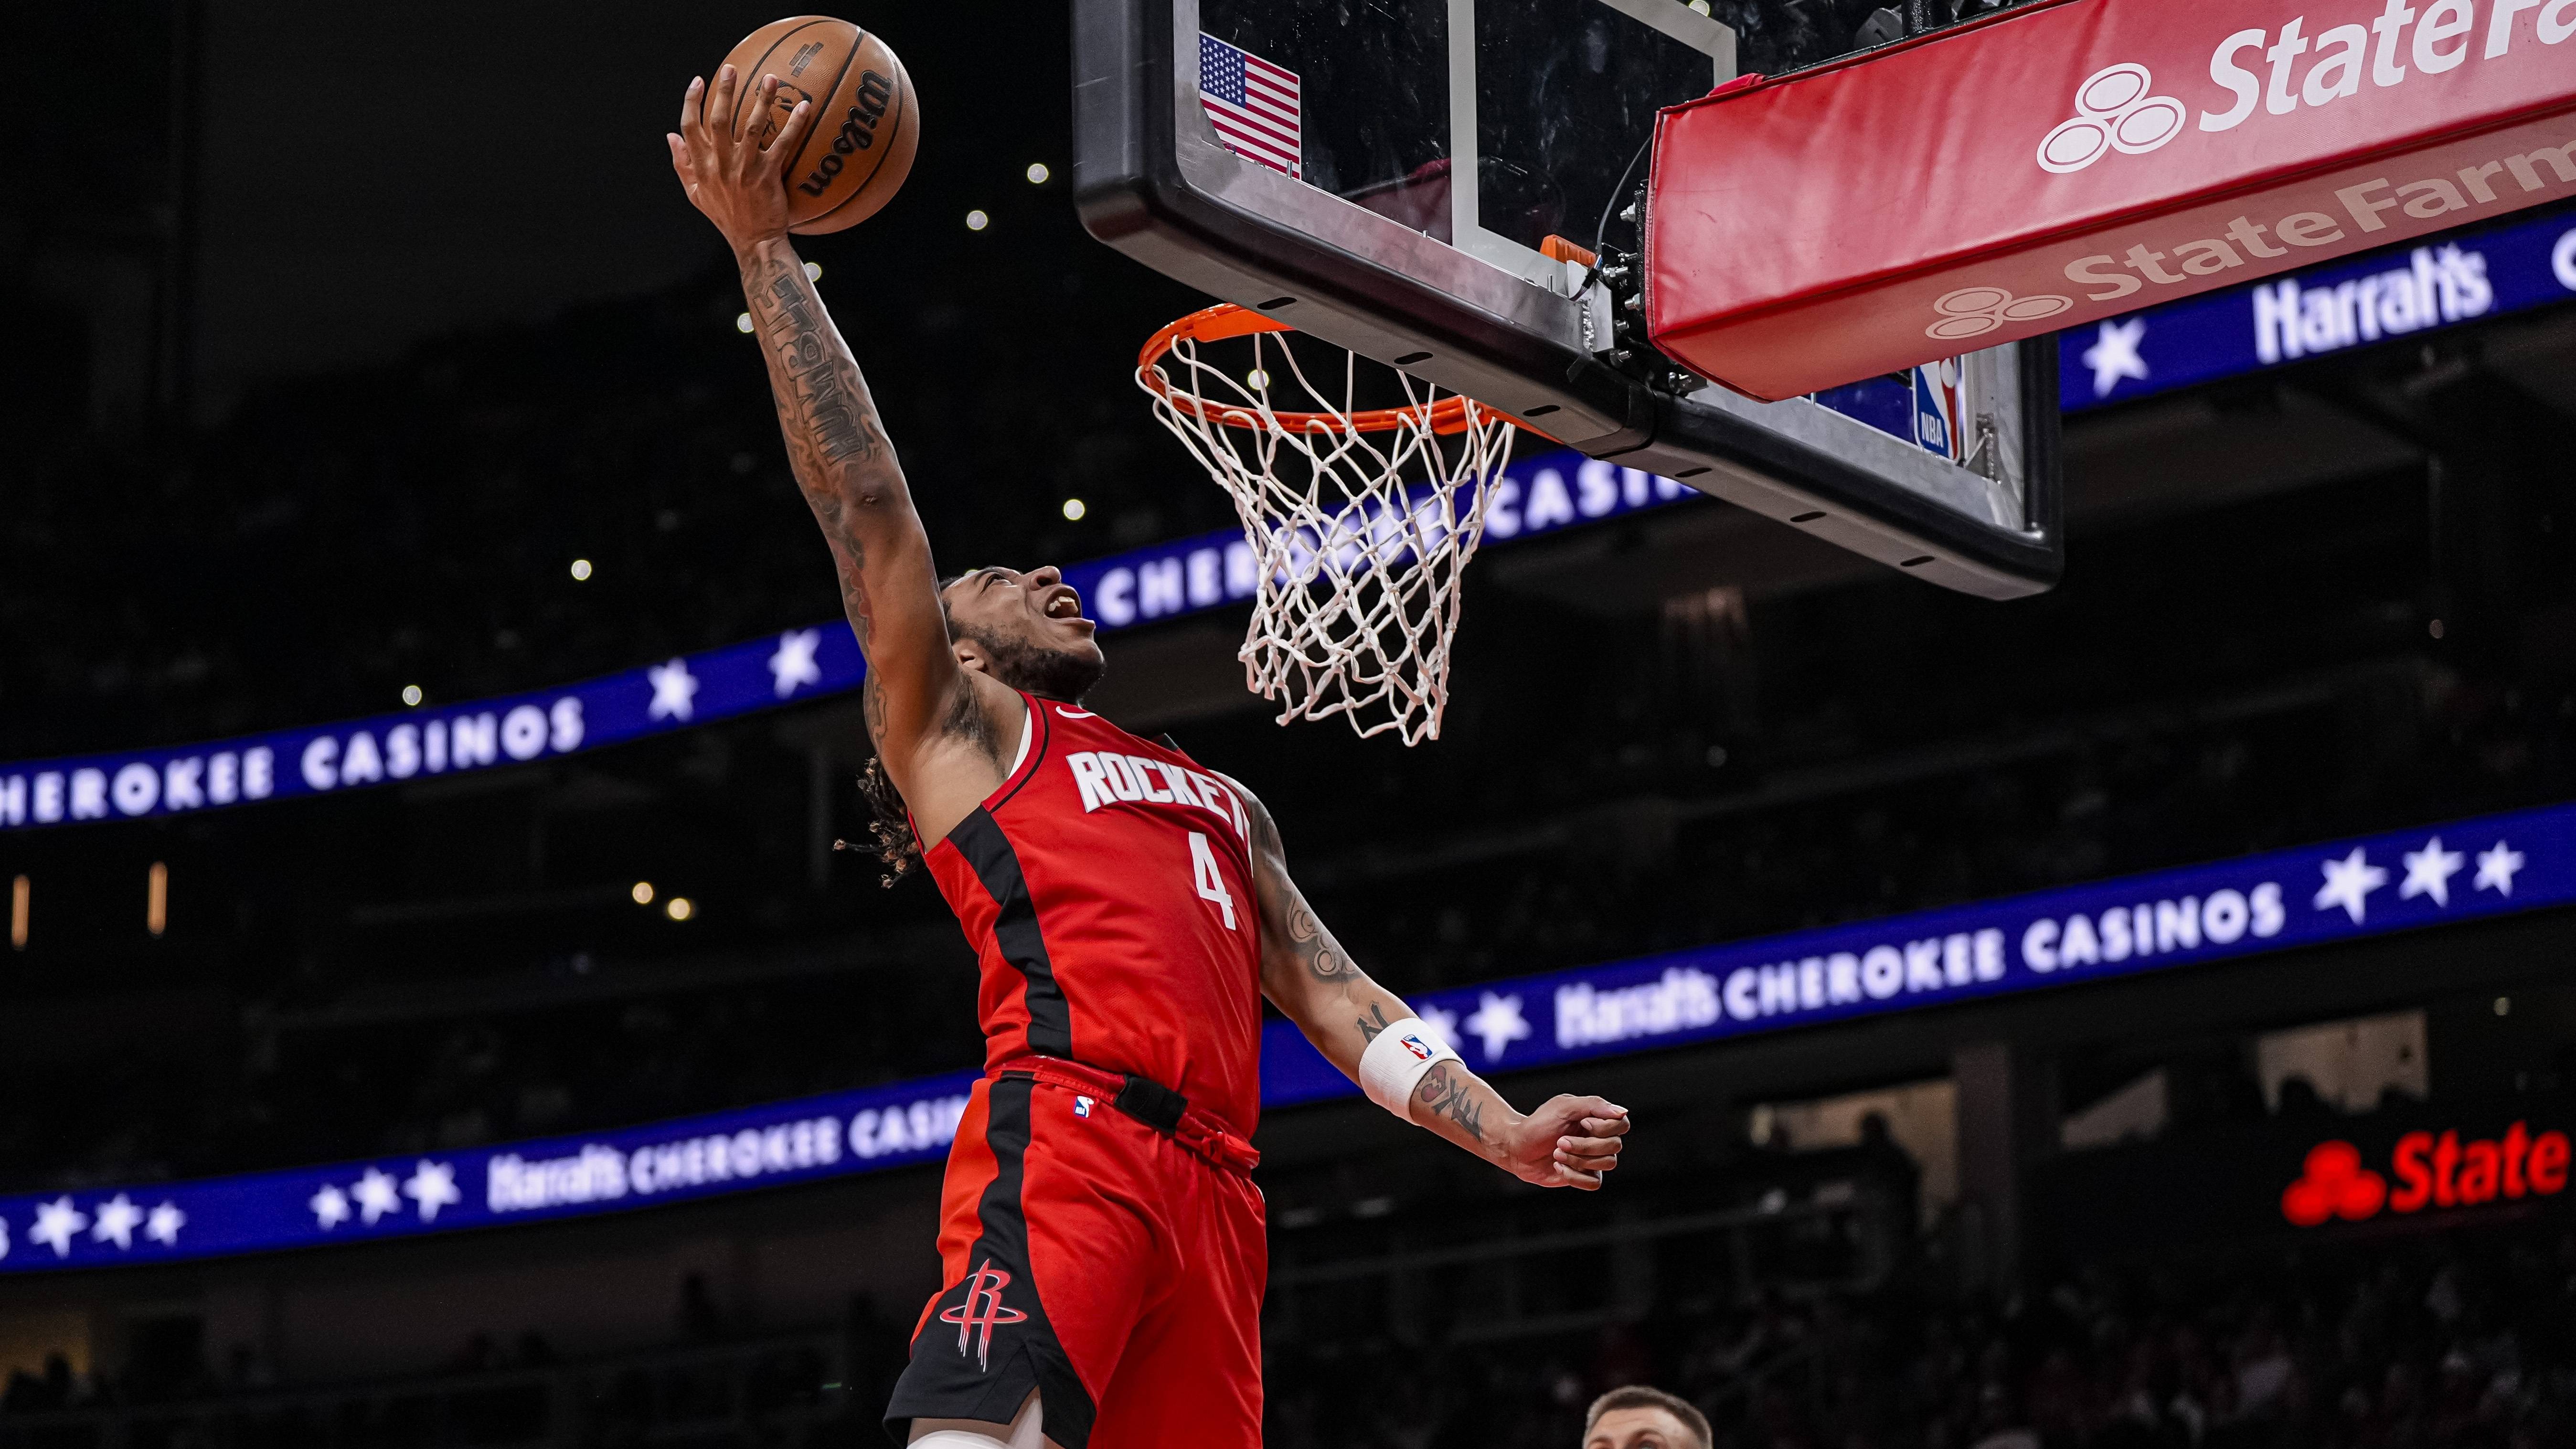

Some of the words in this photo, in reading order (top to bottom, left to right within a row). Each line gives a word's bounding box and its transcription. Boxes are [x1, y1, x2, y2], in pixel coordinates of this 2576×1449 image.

[798, 70, 893, 197] Wilson
[2251, 242, 2494, 364] Harrah's
[753, 273, 862, 467] HUMBLE
[1921, 412, 1944, 447] NBA
[301, 696, 585, 790] CASINOS
[1188, 831, 1236, 931] 4
[1723, 927, 2006, 1021] CHEROKEE
[2021, 880, 2286, 973] CASINOS
[629, 1115, 843, 1194] CHEROKEE
[2389, 1120, 2571, 1213] State
